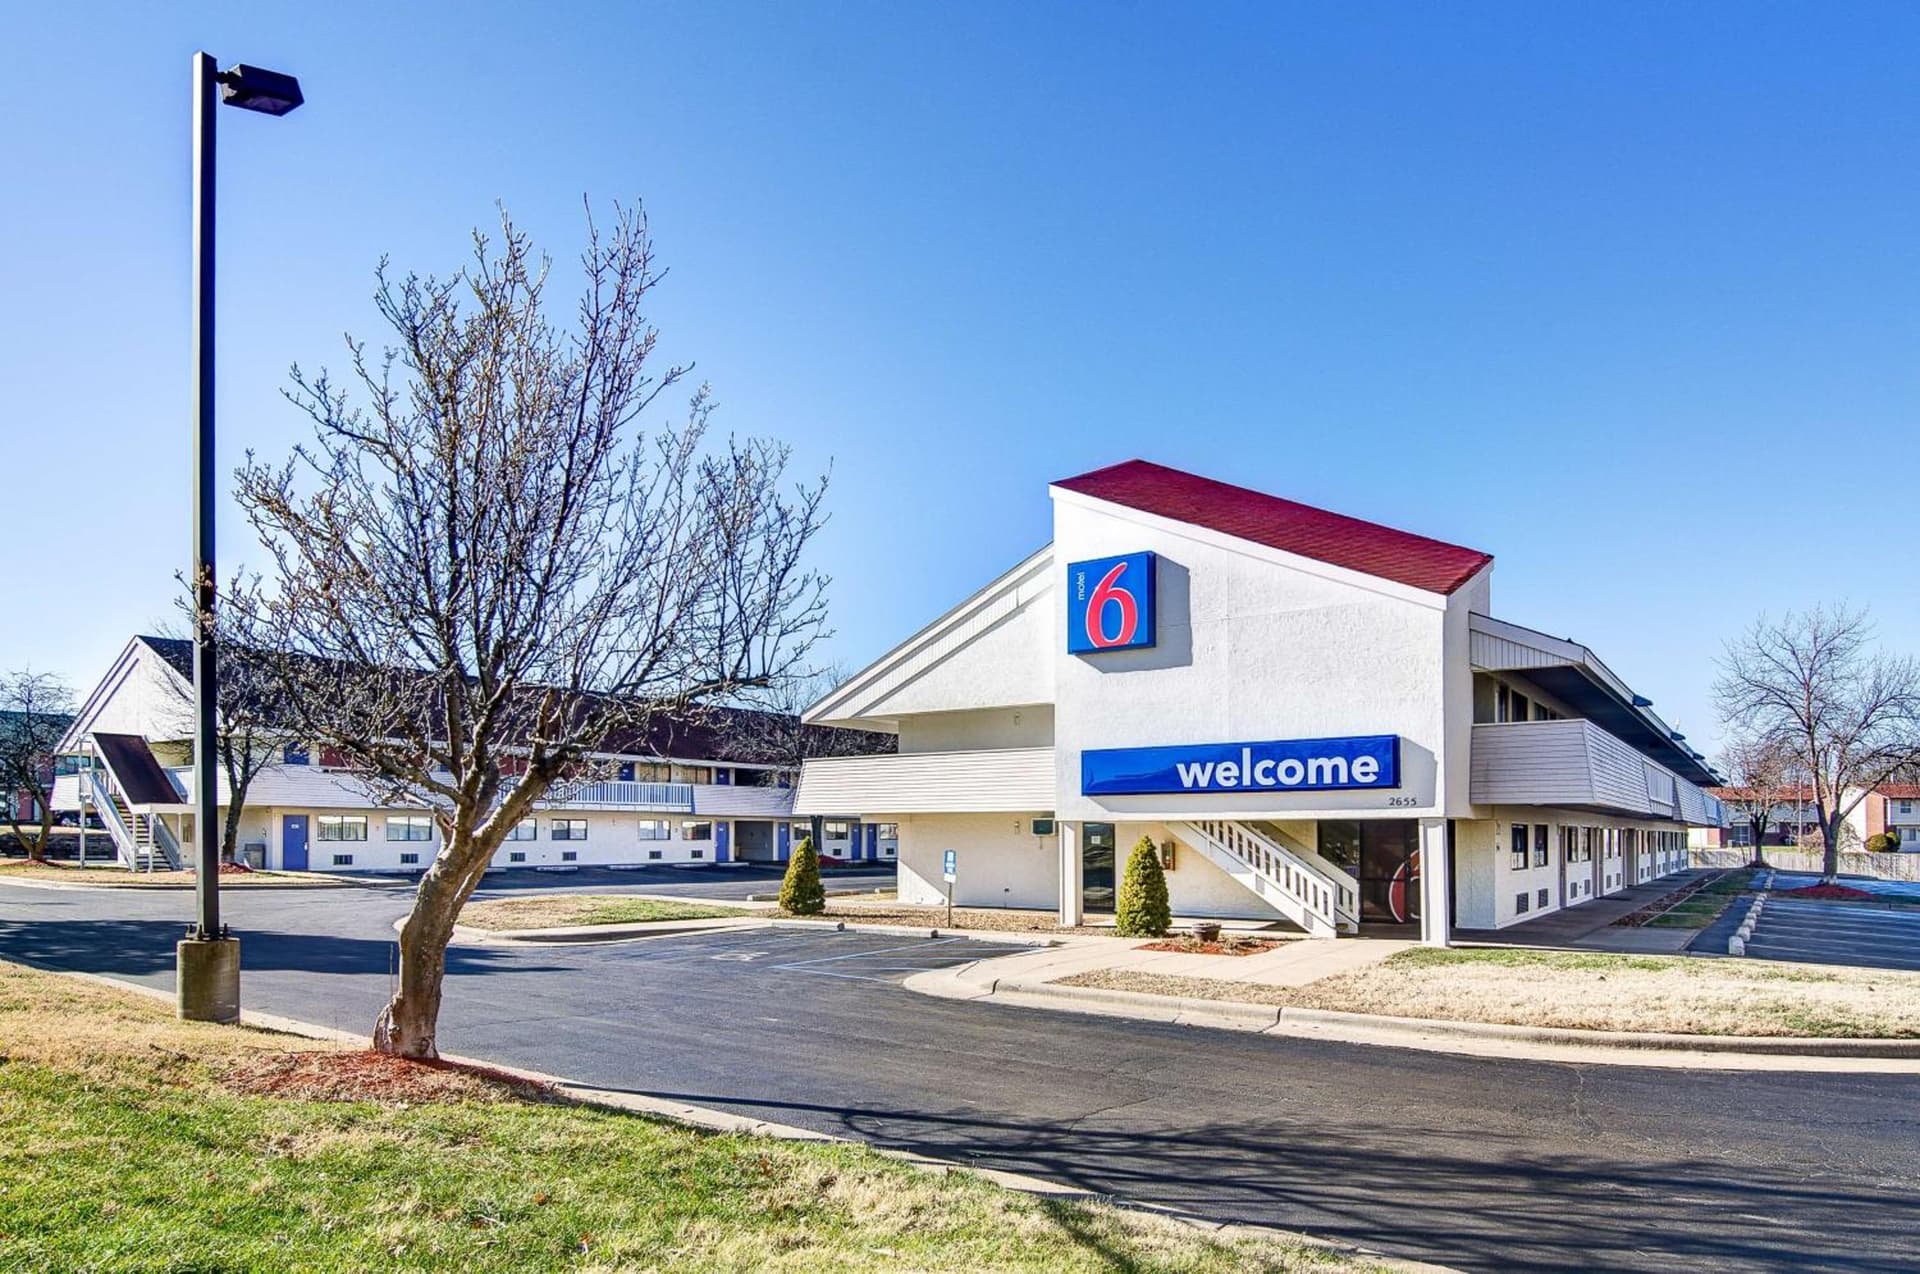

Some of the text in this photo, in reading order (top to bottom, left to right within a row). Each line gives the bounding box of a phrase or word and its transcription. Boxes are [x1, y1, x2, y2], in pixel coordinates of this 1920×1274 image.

[1076, 571, 1086, 600] motel
[1085, 561, 1138, 648] 6
[1175, 747, 1380, 788] welcome
[1388, 796, 1417, 807] 2655
